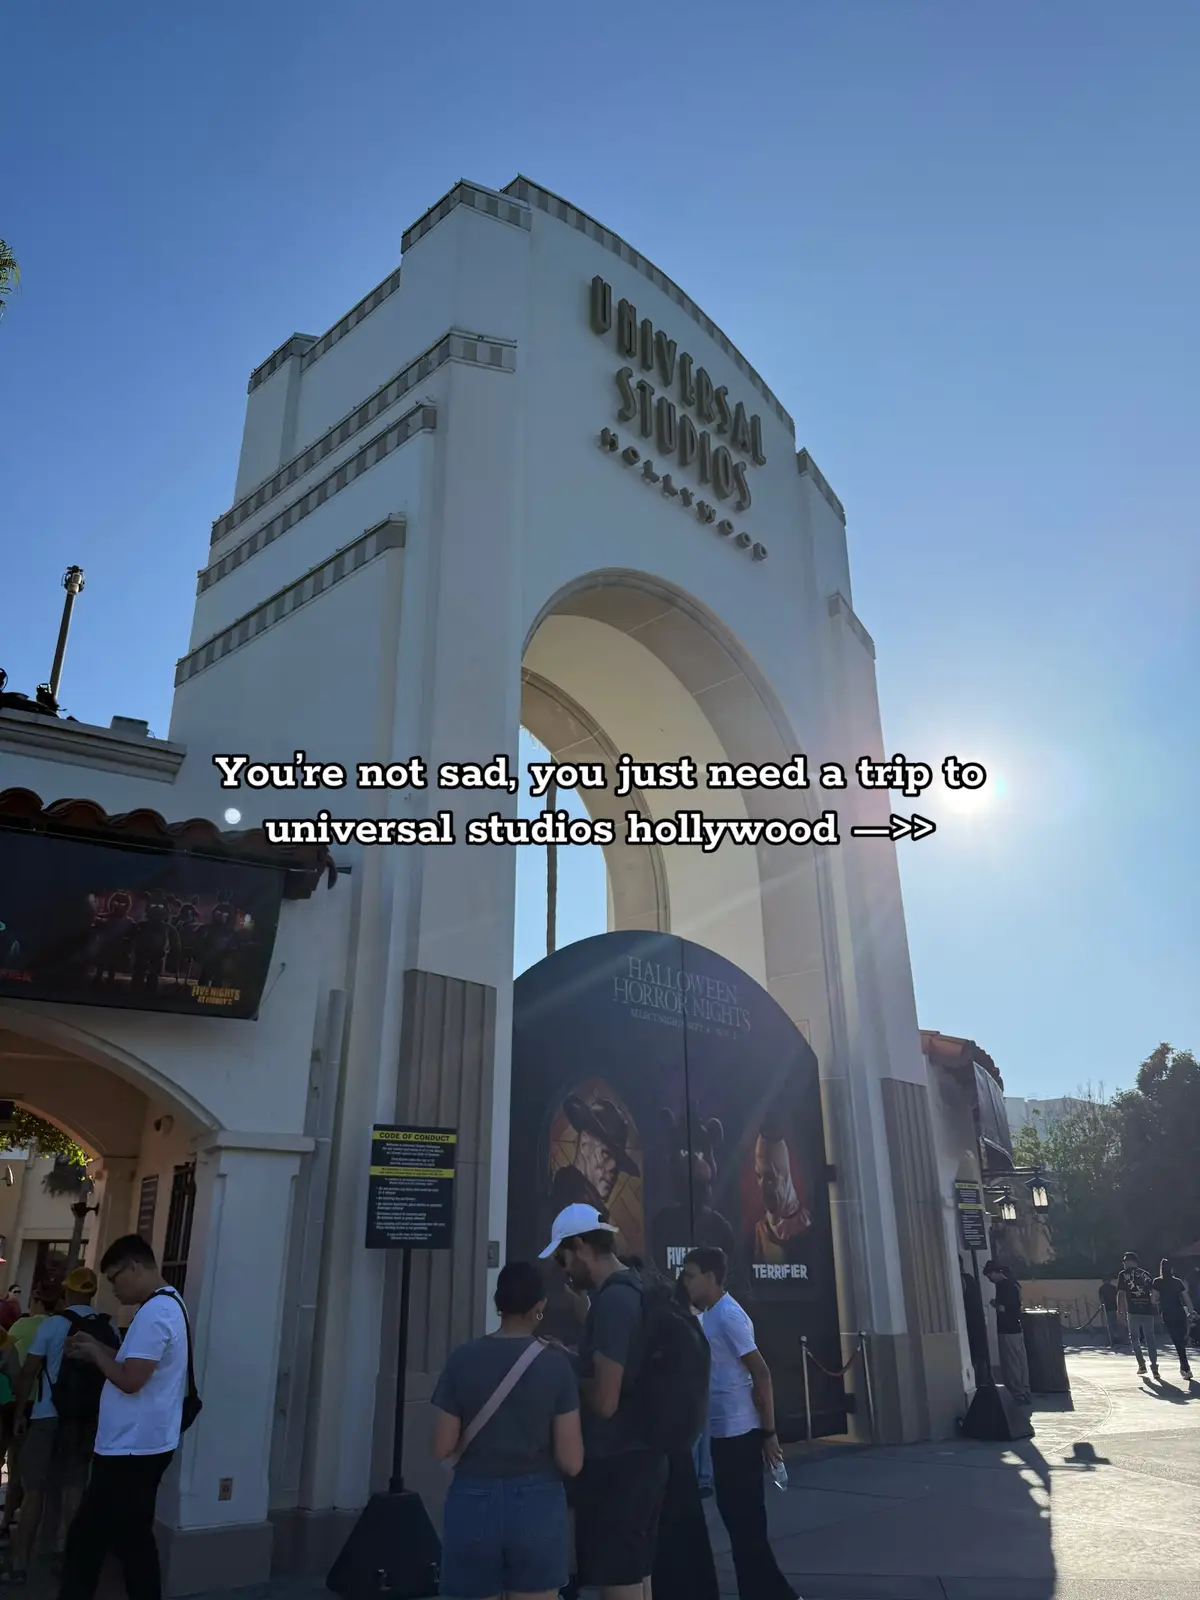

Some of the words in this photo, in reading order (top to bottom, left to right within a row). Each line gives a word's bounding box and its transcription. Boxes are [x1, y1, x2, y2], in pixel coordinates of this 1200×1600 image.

[592, 275, 767, 466] UNIVERSAL
[615, 366, 751, 512] STUDIOS
[600, 427, 768, 562] HOLLYWOOD
[191, 985, 210, 997] FIVE
[210, 987, 241, 1001] NIGHTS
[613, 976, 688, 1016] HORROR
[691, 996, 751, 1032] NIGHTS
[627, 956, 738, 1004] HALLOWEEN
[414, 1134, 450, 1142] CONDUCT
[752, 1263, 809, 1279] TERRIFIER
